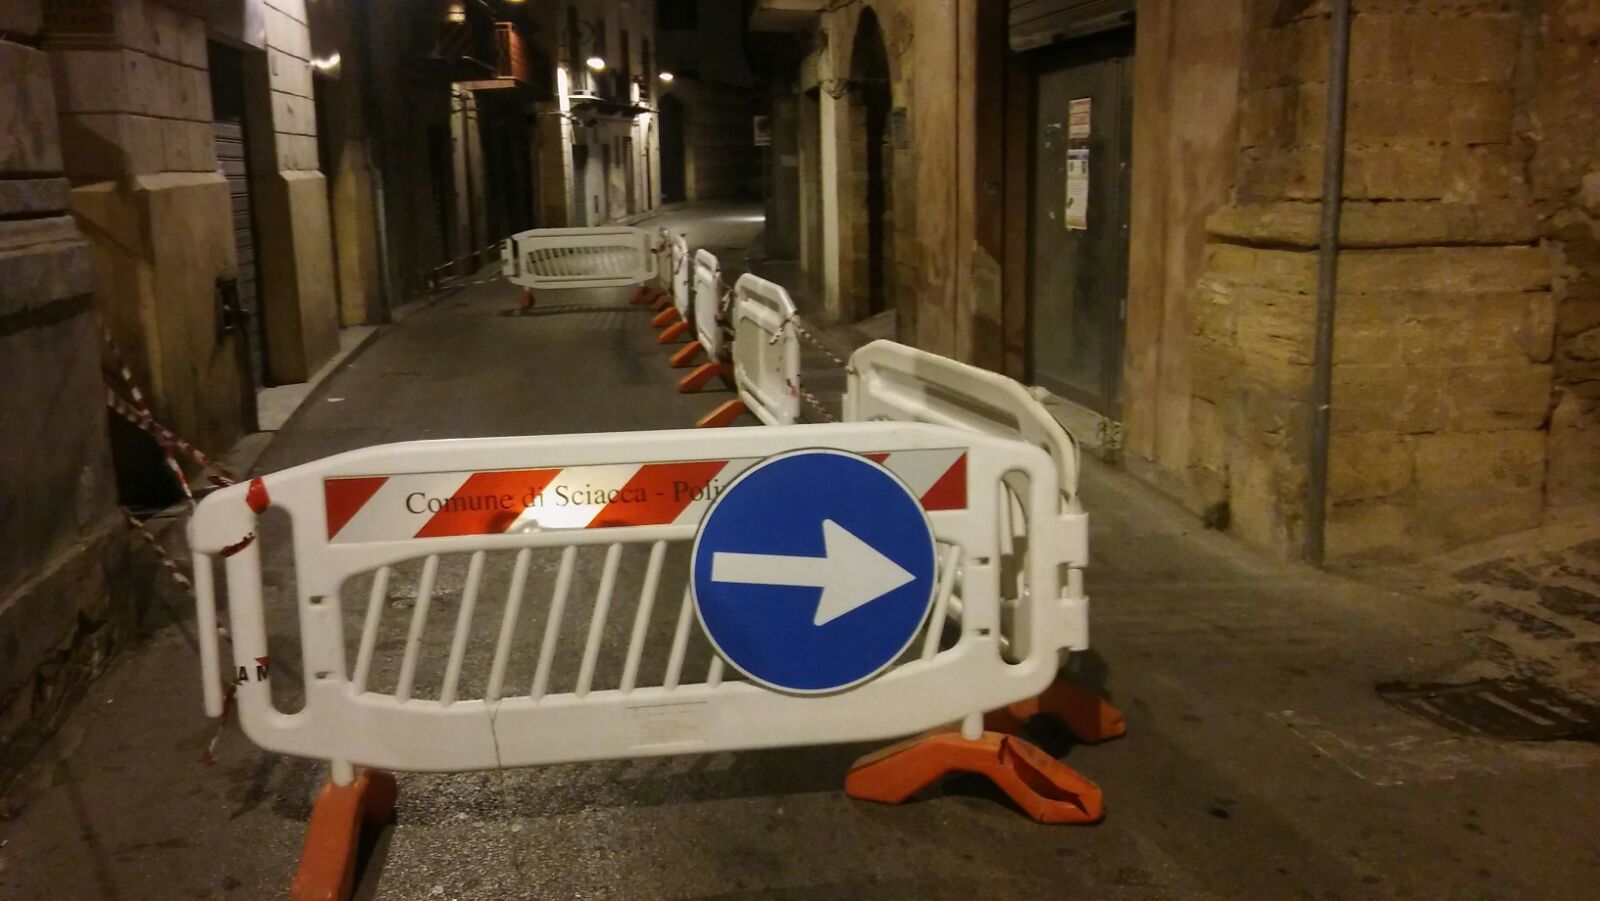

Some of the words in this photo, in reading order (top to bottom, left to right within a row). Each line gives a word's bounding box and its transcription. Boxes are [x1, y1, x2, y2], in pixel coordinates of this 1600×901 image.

[406, 491, 513, 514] Comune
[522, 486, 544, 508] di
[555, 483, 647, 506] Sciacca
[672, 478, 725, 501] Poli
